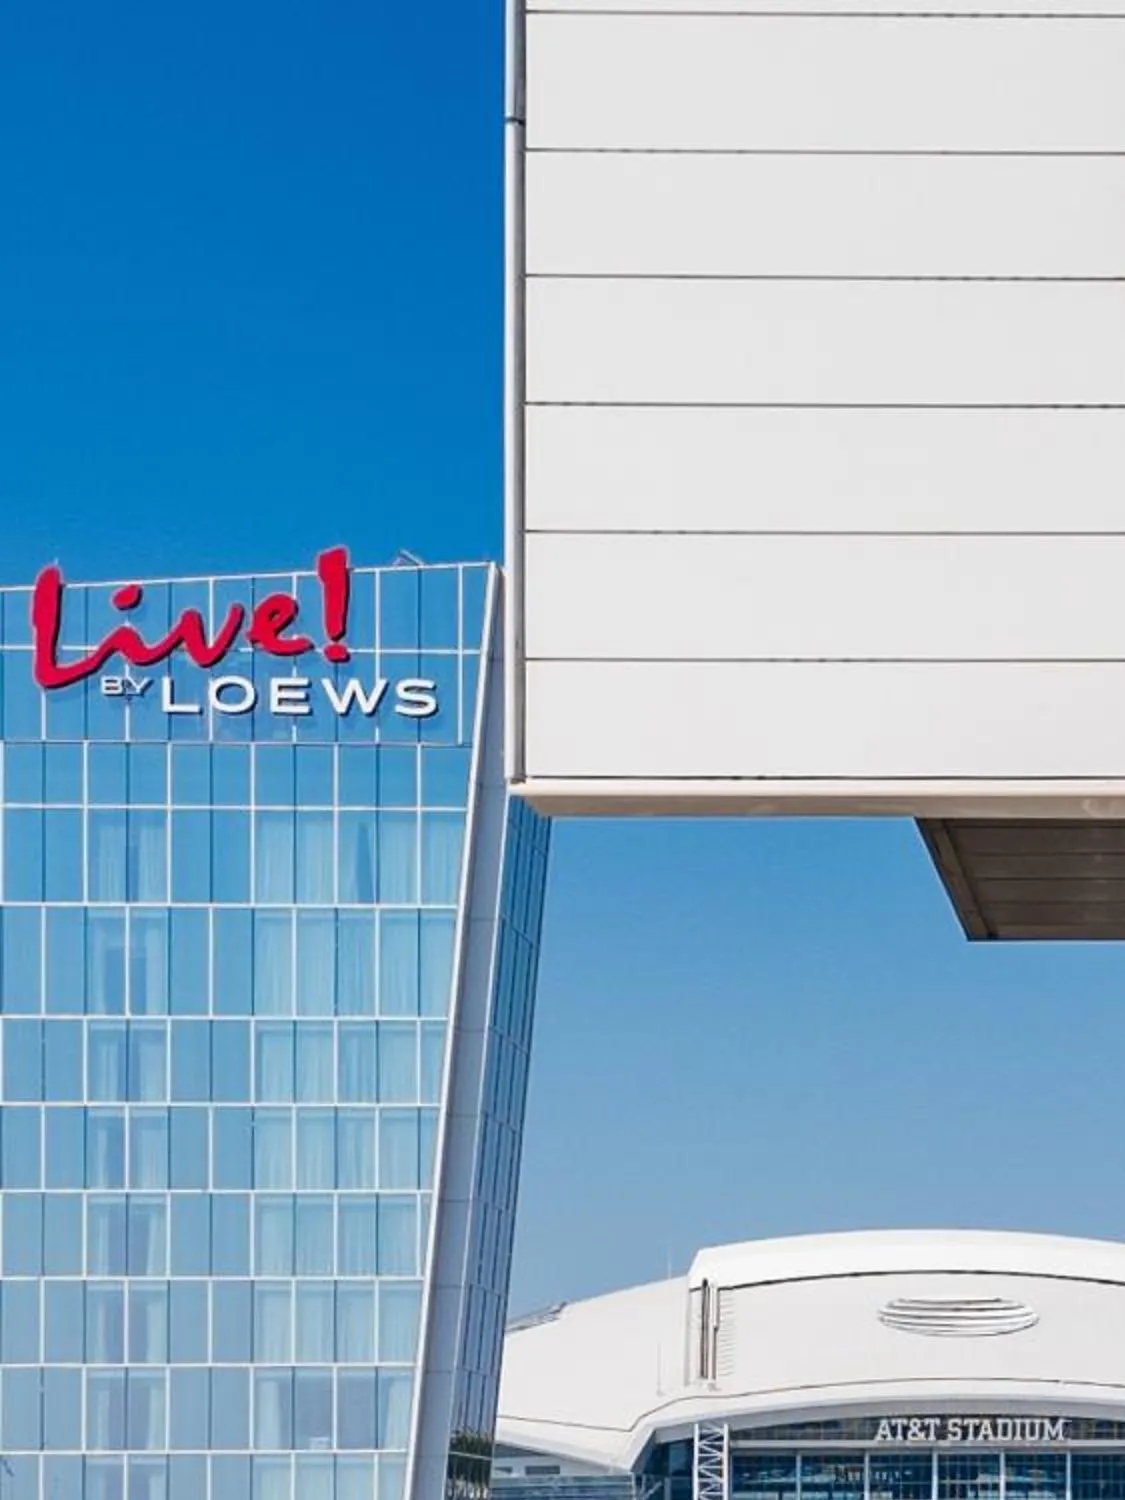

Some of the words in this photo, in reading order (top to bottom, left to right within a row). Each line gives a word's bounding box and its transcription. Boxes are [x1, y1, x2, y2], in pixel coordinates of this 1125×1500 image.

[32, 546, 349, 688] Live!
[102, 676, 153, 696] BY
[162, 676, 440, 716] LOEWS
[875, 1418, 940, 1441] AT&T
[947, 1418, 1066, 1441] STADIUM
